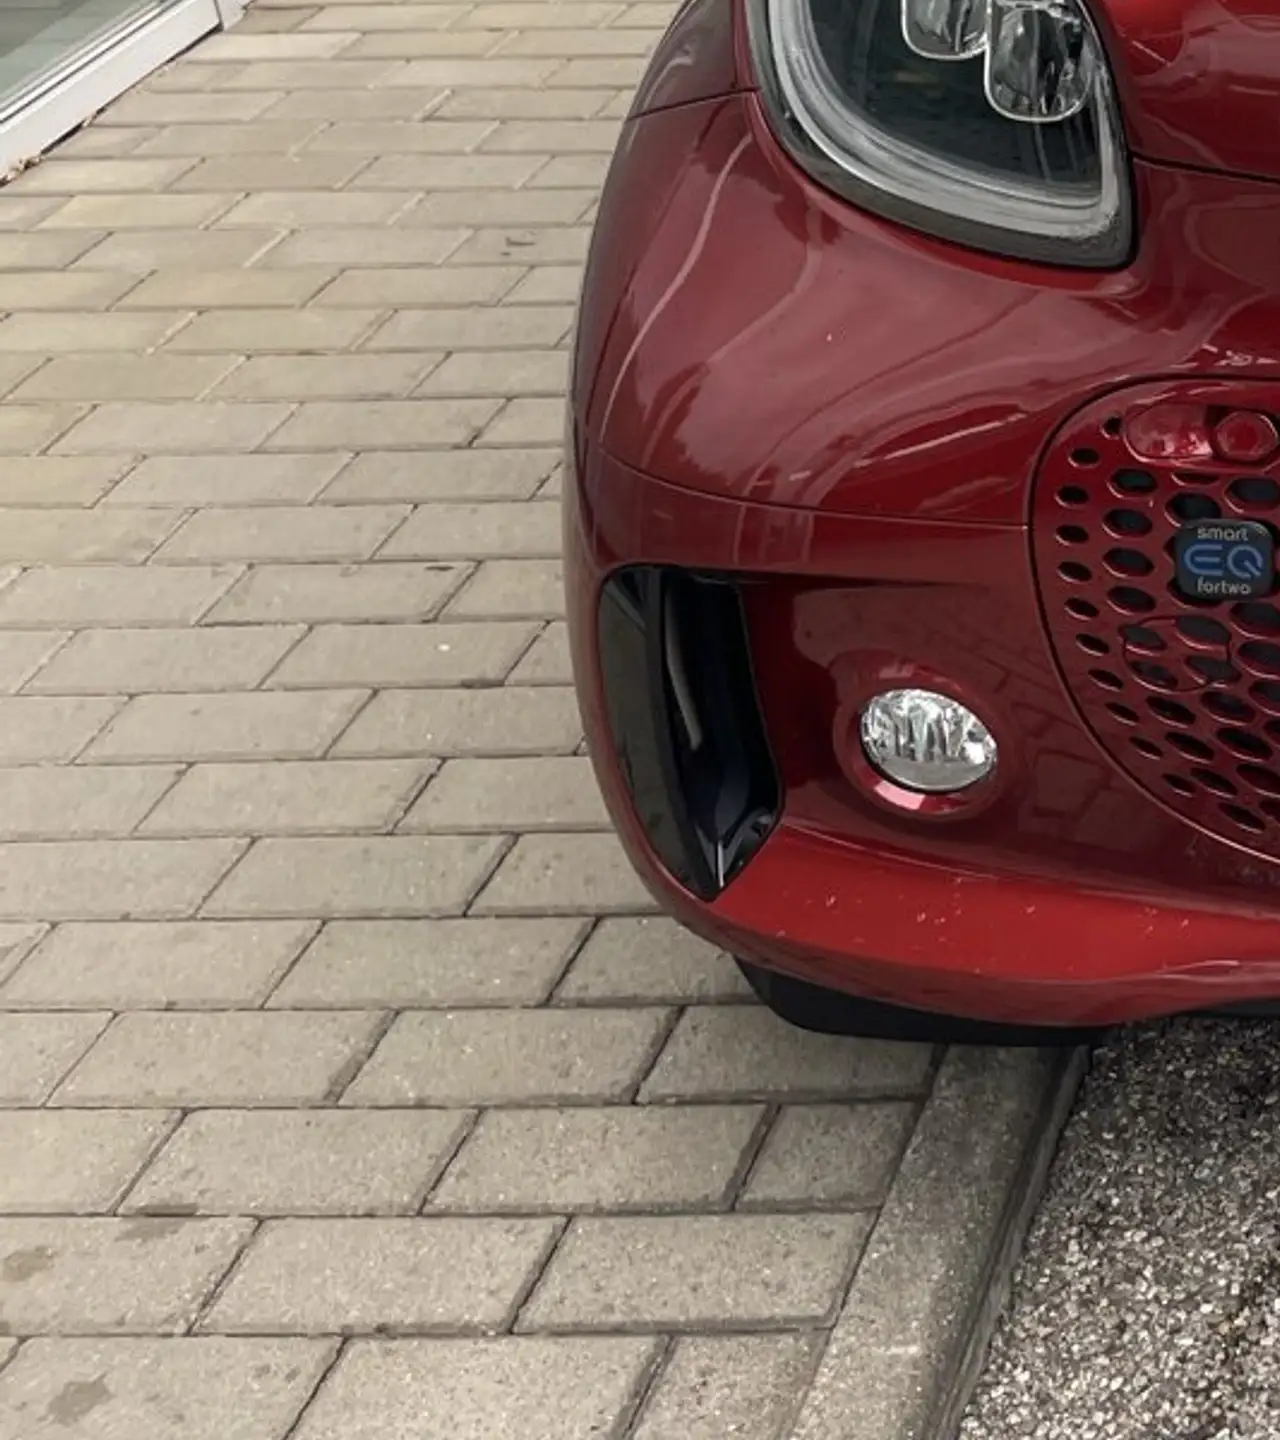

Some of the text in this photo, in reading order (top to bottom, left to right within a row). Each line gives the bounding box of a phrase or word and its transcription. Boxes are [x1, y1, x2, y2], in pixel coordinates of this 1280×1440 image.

[1197, 527, 1249, 541] smart
[1184, 544, 1263, 579] EQ
[1197, 576, 1252, 595] fortwo
